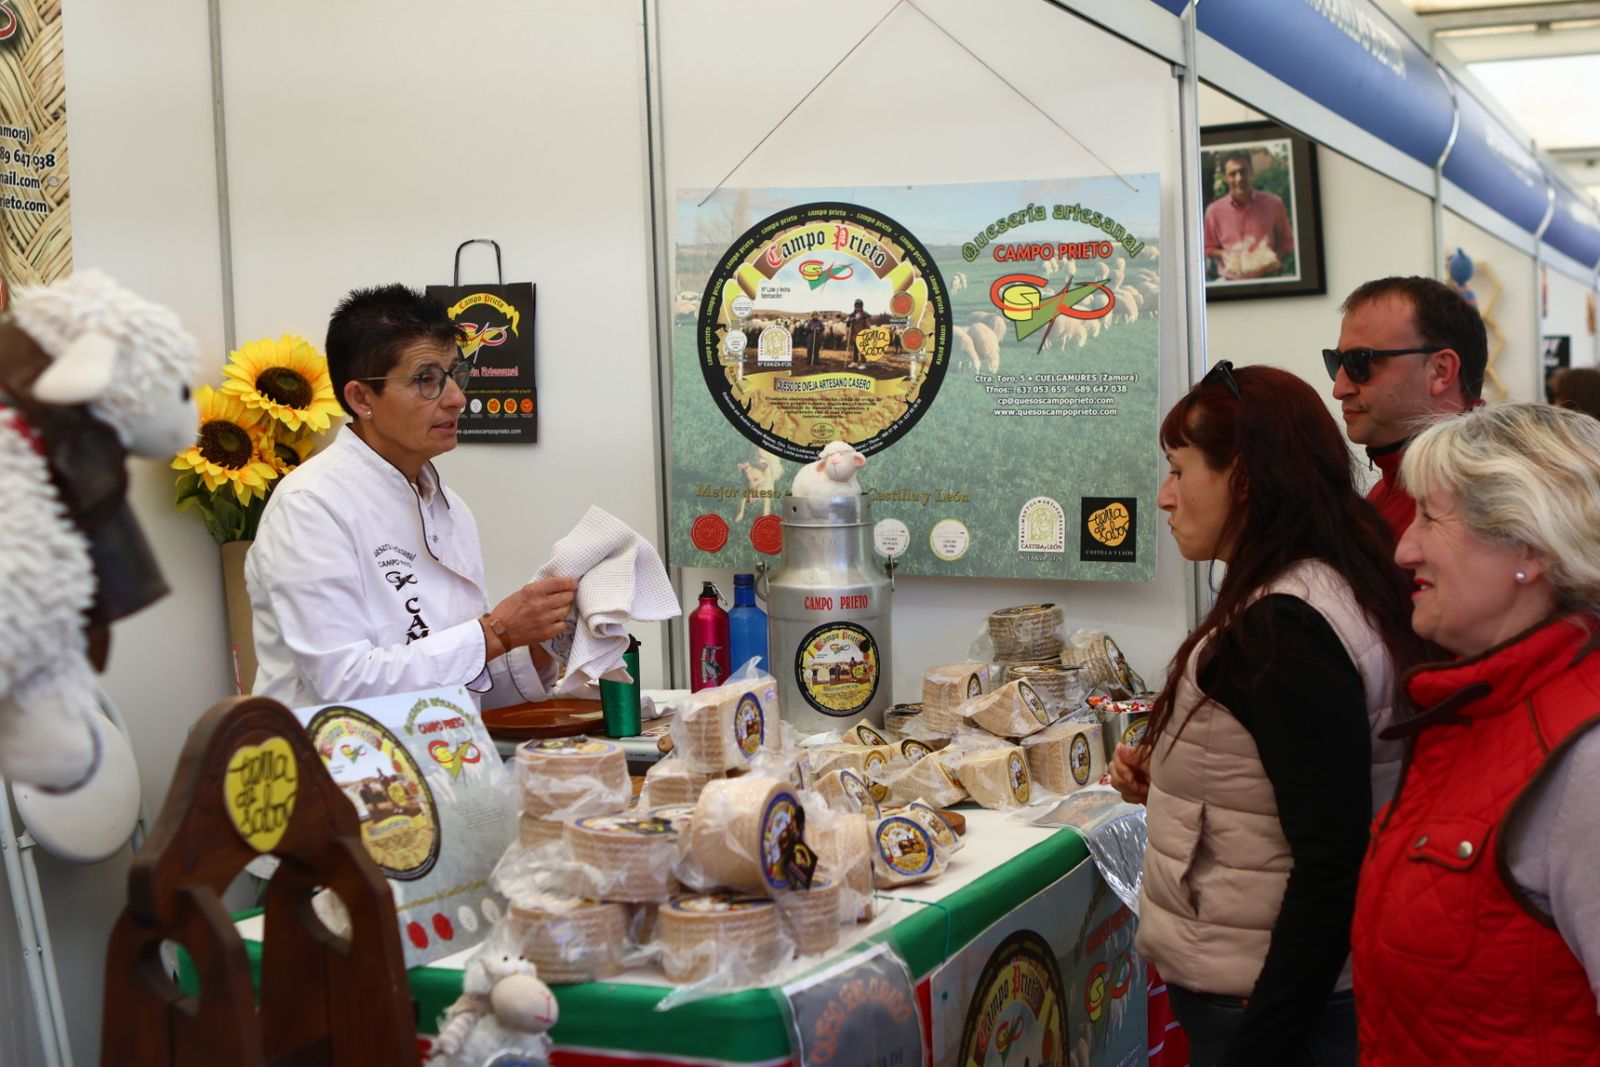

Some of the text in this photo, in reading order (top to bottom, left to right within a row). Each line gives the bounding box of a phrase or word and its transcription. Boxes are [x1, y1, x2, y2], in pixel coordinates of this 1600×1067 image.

[14, 149, 31, 168] 647
[33, 153, 56, 170] 038
[1052, 203, 1145, 258] artesanal
[766, 225, 886, 268] Campo Prieto
[993, 241, 1113, 262] CAMPO PRIETO
[459, 295, 504, 309] Campo Prieto
[776, 377, 871, 391] QUESO DE OVEJA ARTESANO CASERO
[975, 373, 1139, 383] Ctra. Toro, 5 CUELGAMURES (Zamora)
[1016, 385, 1032, 393] 637
[1033, 385, 1049, 393] 053
[1051, 385, 1067, 393] 659
[1075, 385, 1091, 393] 689
[1093, 385, 1109, 393] 647
[1111, 385, 1127, 393] 038
[997, 397, 1114, 406] cp@quesoscampoprieto.com
[993, 408, 1117, 417] www.quesoscampoprieto.com
[695, 484, 739, 502] Mejor
[743, 488, 782, 502] queso
[920, 491, 931, 506] y
[935, 488, 971, 503] León
[804, 594, 868, 611] CAMPO PRIETO
[976, 964, 1041, 1051] Campo Prieto
